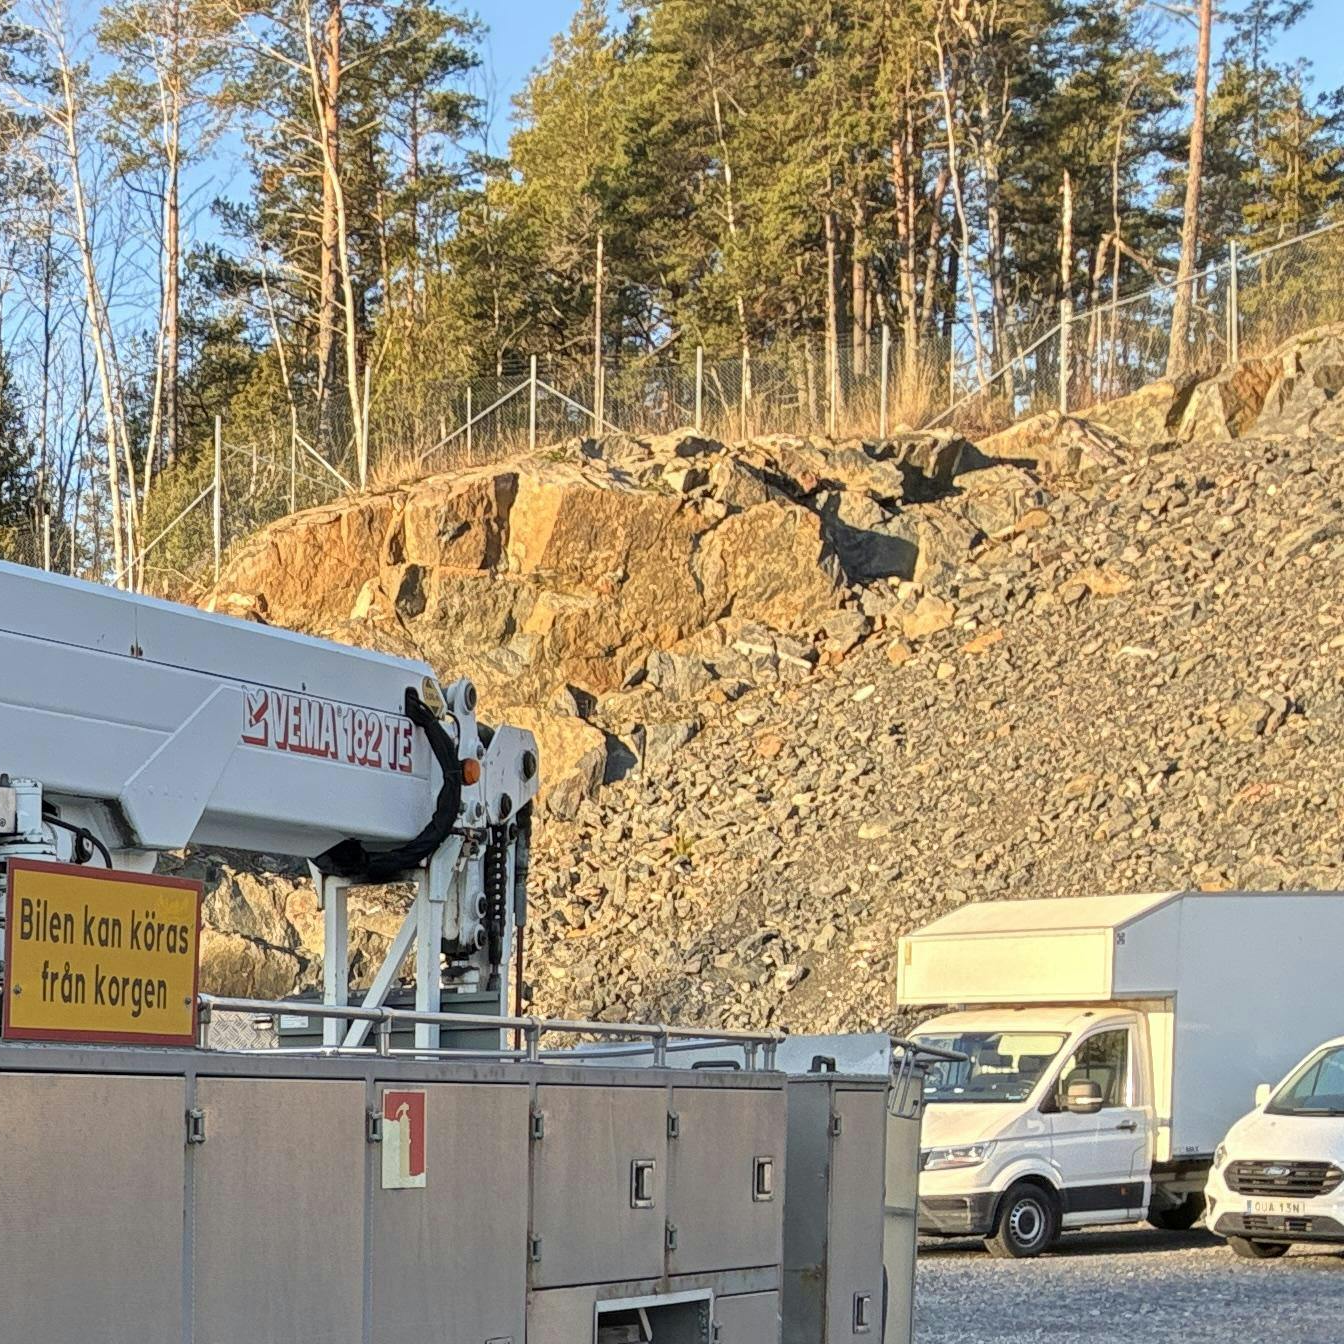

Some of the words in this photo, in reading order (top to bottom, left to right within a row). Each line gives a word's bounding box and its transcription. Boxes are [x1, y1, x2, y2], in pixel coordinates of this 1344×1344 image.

[271, 691, 339, 760] VEMA
[343, 707, 382, 768] 182
[385, 715, 413, 773] TE
[20, 898, 74, 945] Bilen
[83, 904, 122, 949] kan
[130, 908, 189, 954] köras
[41, 960, 85, 1004] från
[94, 963, 167, 1018] korgen
